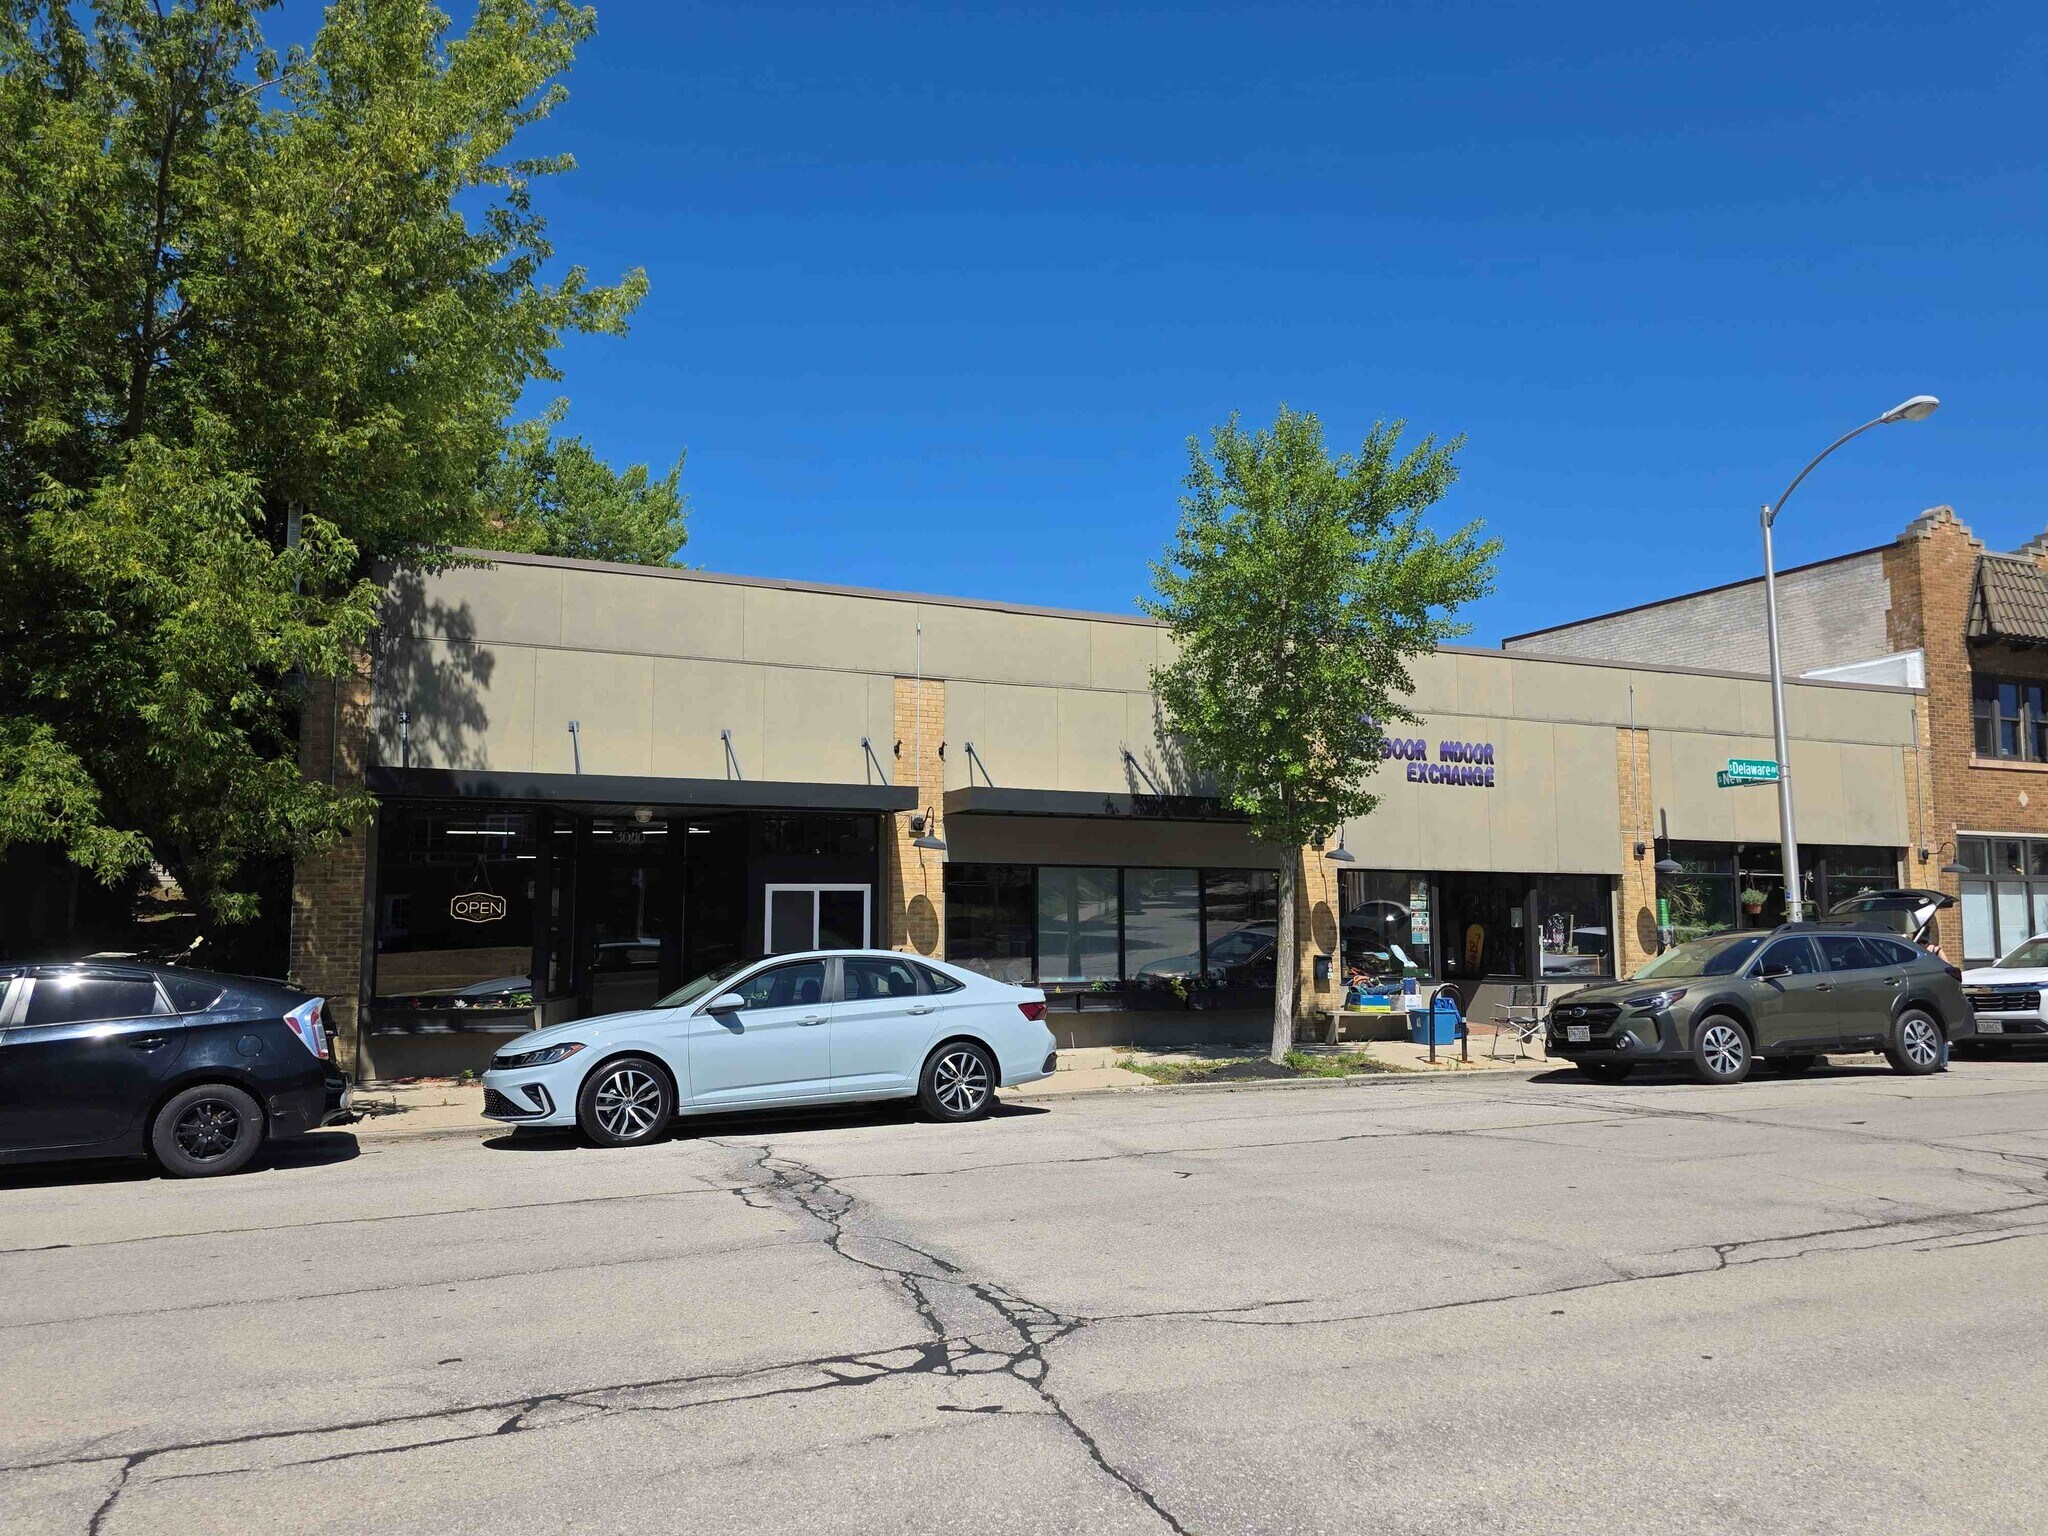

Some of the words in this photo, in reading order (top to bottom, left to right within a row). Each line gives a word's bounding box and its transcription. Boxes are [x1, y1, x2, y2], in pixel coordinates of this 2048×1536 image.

[1440, 740, 1494, 764] INDOOR
[1407, 762, 1494, 787] EXCHANGE
[1732, 761, 1770, 776] Delaware
[455, 901, 502, 914] OPEN
